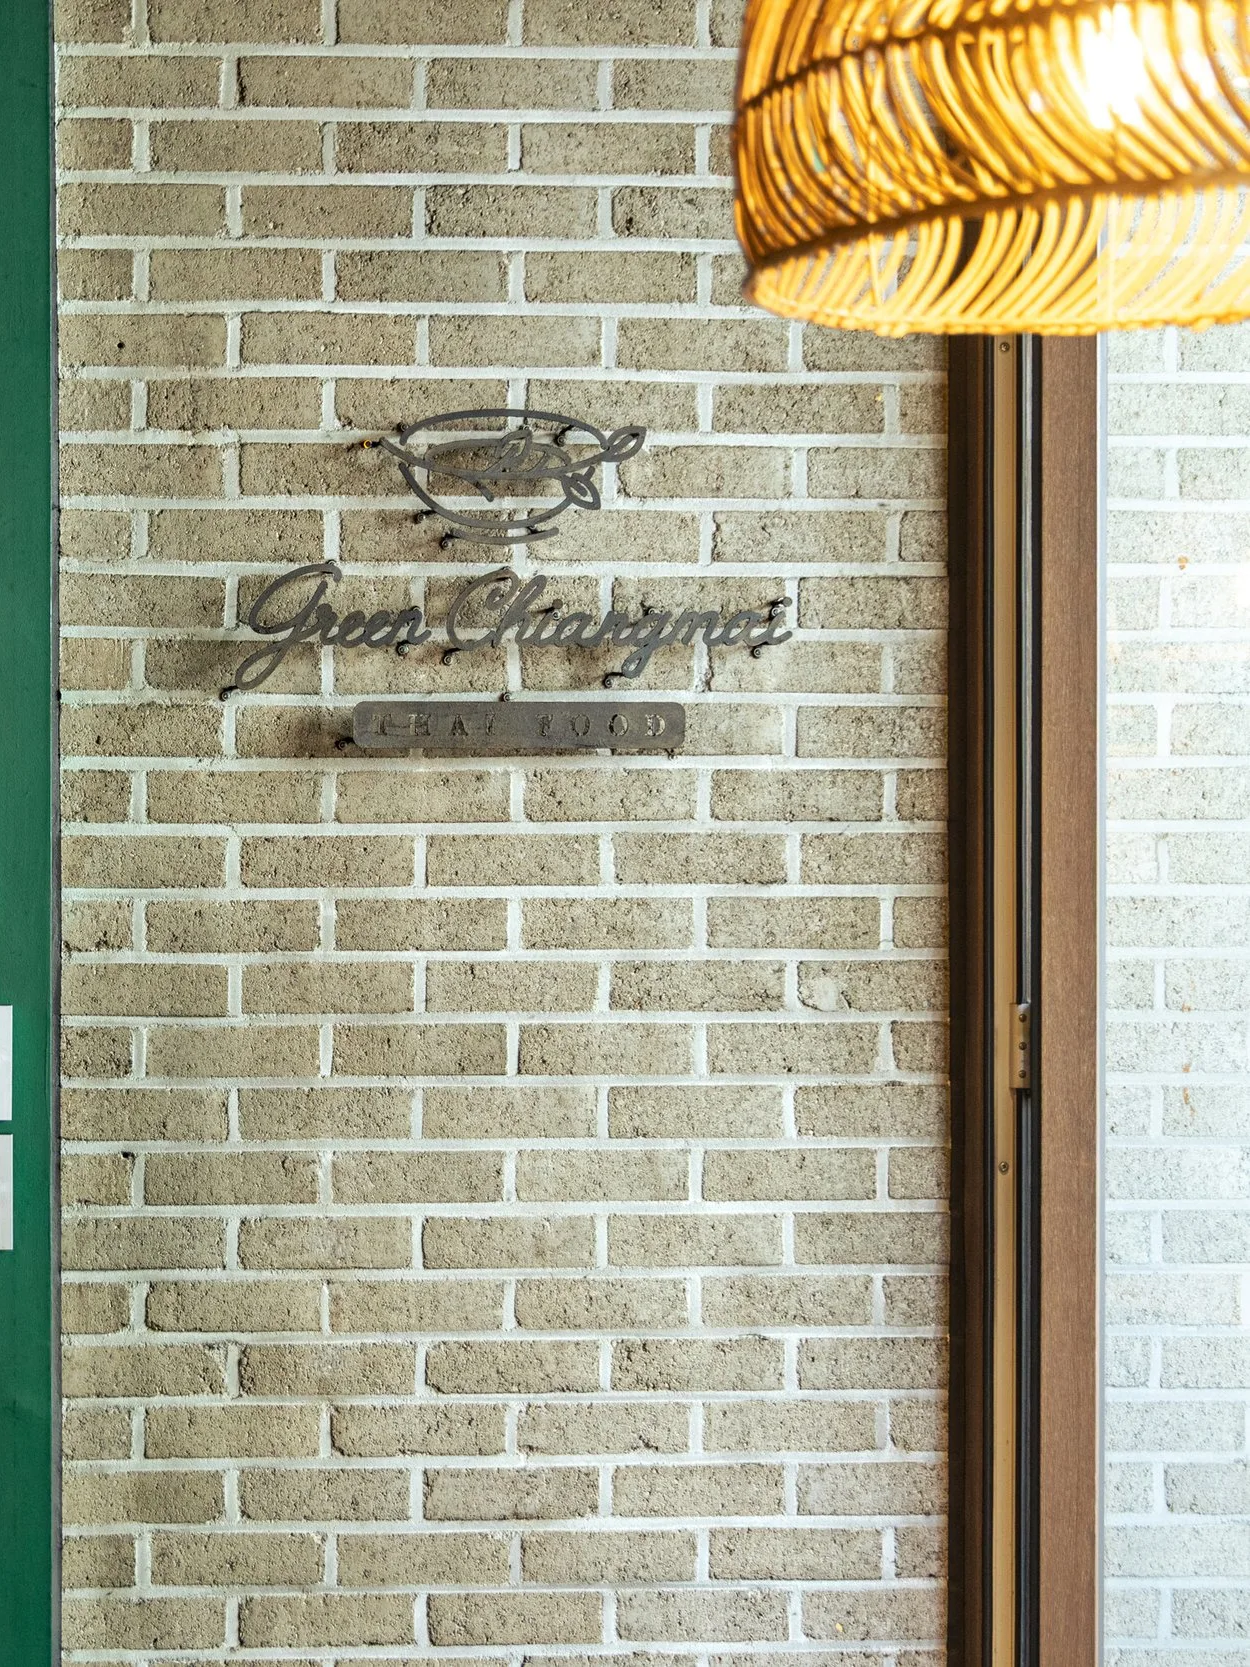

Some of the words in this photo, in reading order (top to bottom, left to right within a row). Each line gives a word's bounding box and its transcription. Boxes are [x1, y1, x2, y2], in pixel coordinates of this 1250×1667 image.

[234, 563, 432, 690] Green
[446, 567, 793, 678] Chiangmai
[371, 712, 496, 736] THAI
[535, 712, 666, 737] FOOD
